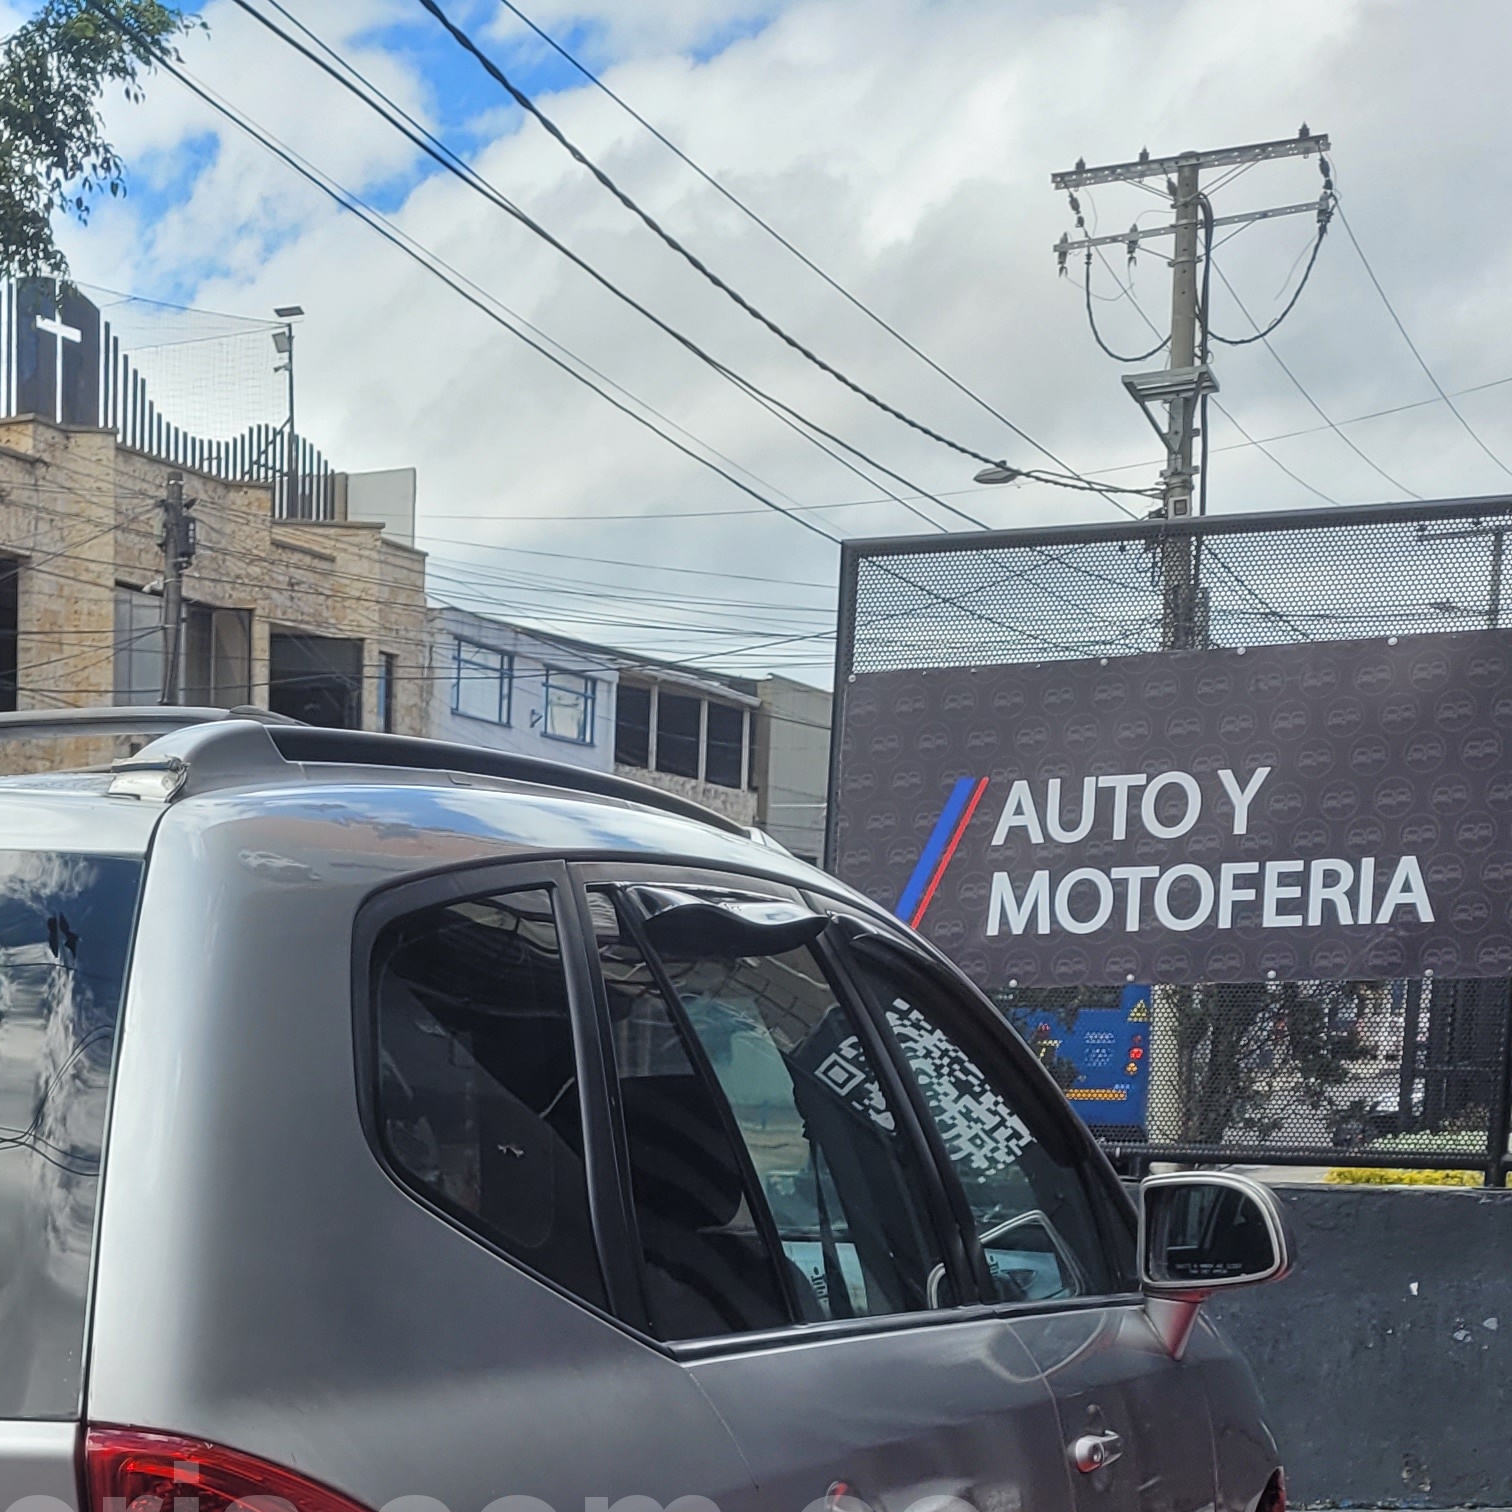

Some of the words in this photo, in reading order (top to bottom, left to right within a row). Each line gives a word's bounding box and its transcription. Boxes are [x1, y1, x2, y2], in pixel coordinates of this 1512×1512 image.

[990, 770, 1202, 845] AUTO
[1217, 766, 1272, 835] Y
[986, 855, 1436, 936] MOTOFERIA
